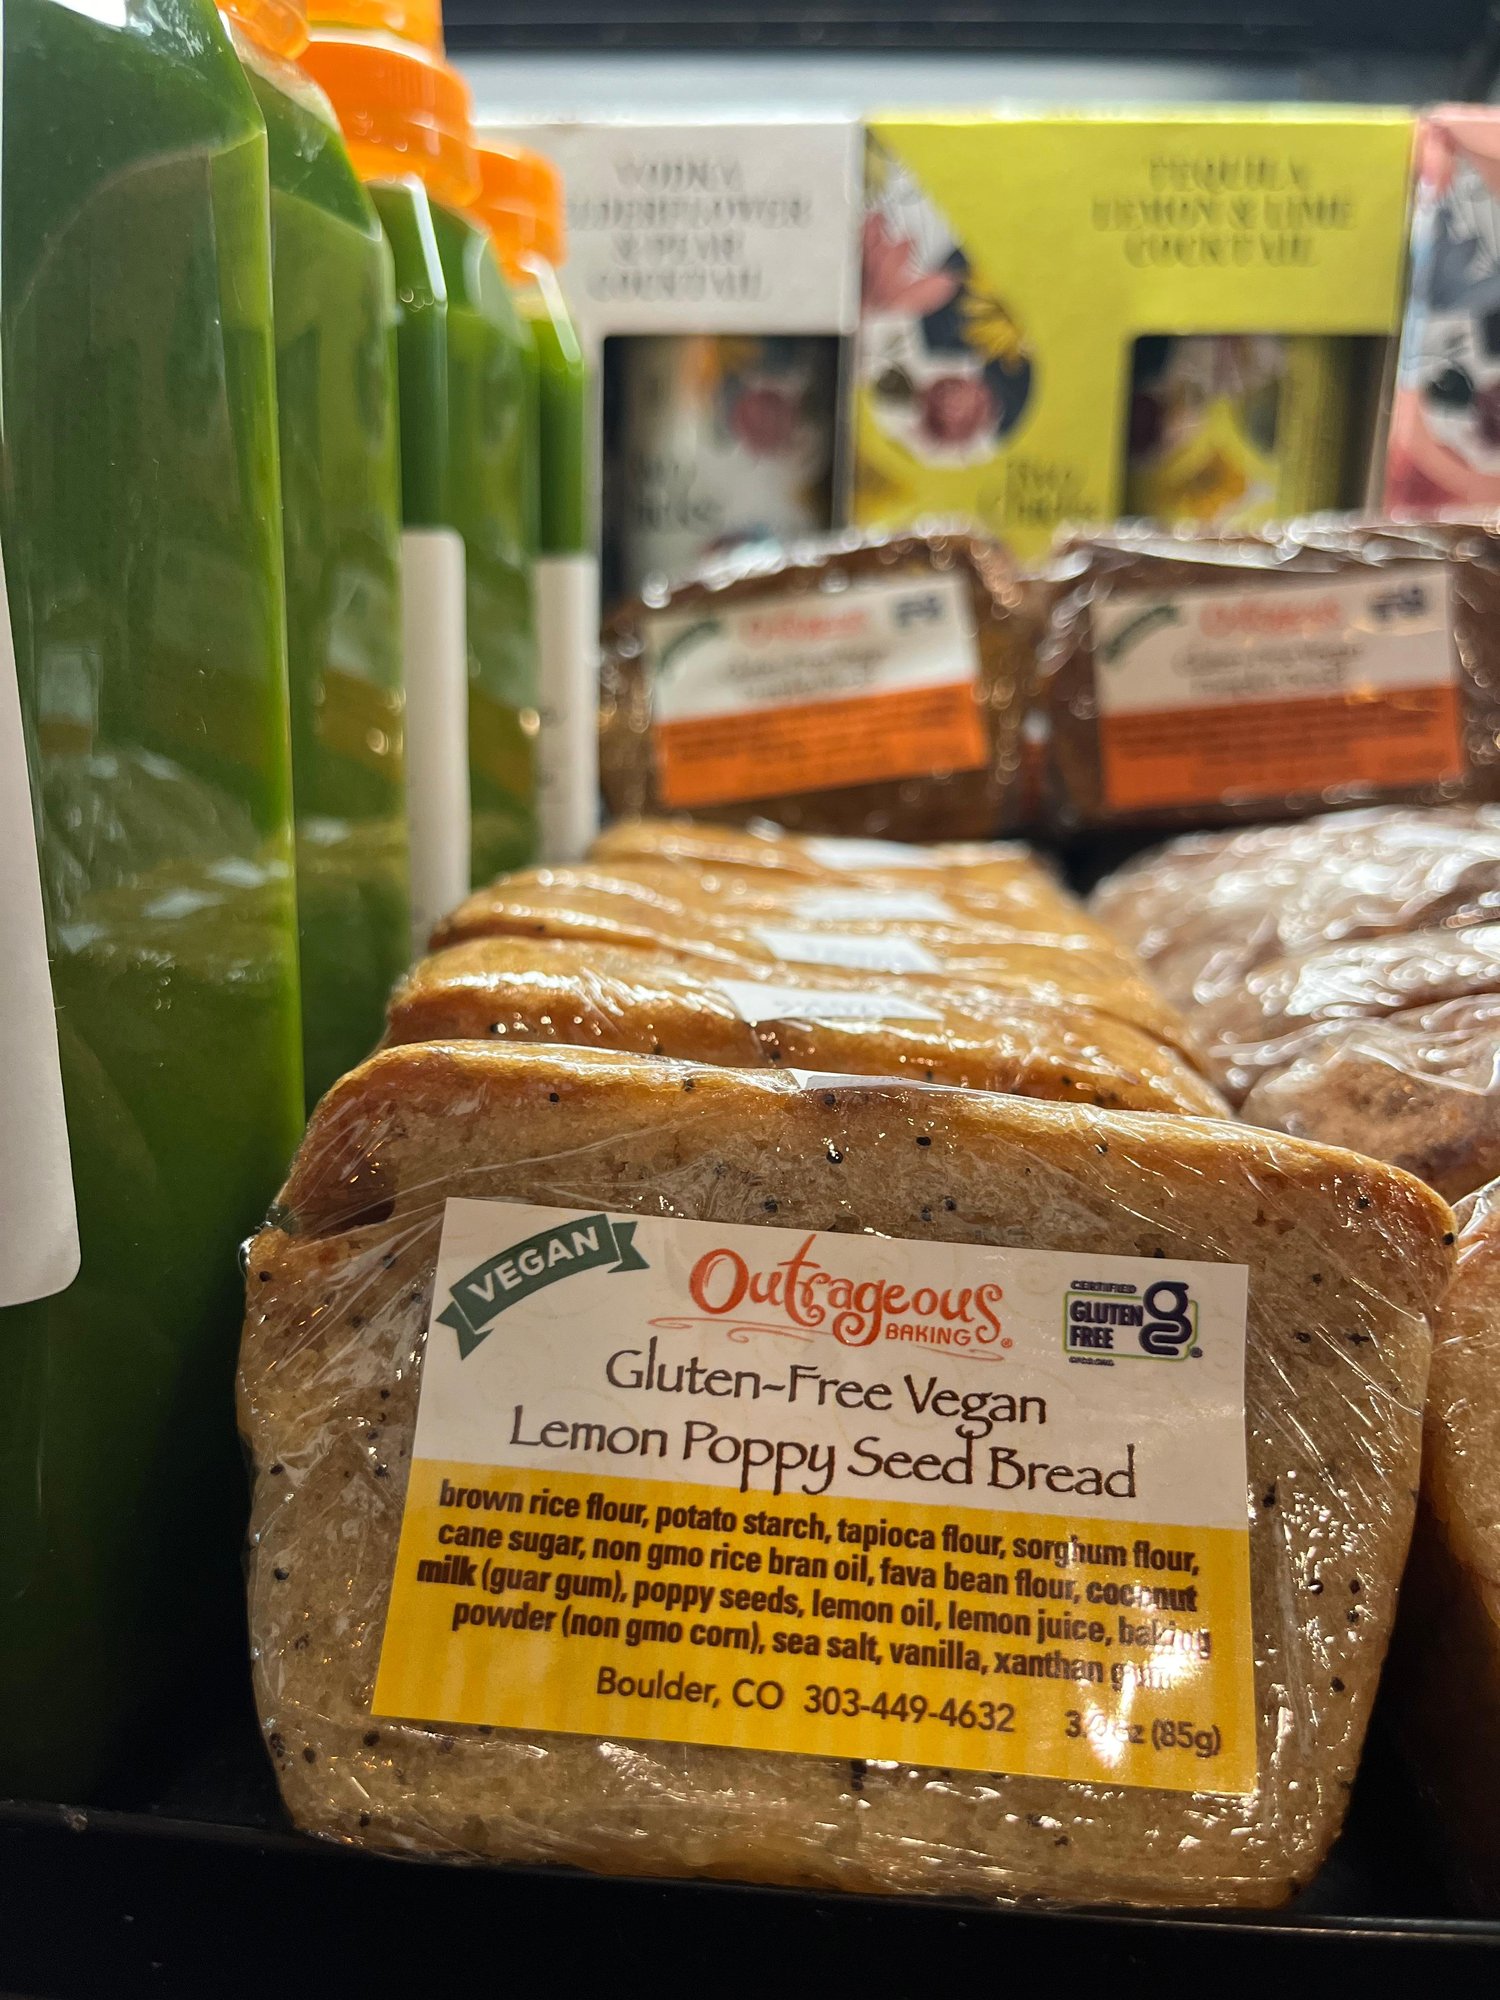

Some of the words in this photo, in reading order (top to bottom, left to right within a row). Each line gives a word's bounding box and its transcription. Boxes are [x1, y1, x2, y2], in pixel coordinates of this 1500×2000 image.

[466, 1225, 601, 1303] VEGAN
[688, 1234, 1004, 1347] Outrageous
[885, 1323, 972, 1347] BAKING
[1069, 1300, 1144, 1327] GLUTEN
[1069, 1325, 1114, 1349] FREE
[606, 1336, 893, 1411] Gluten-Free
[904, 1374, 1047, 1439] Vegan
[509, 1405, 668, 1457] Lemon
[683, 1420, 836, 1496] Poppy
[847, 1431, 973, 1485] Seed
[987, 1443, 1137, 1499] Bread
[438, 1522, 502, 1549] cane
[508, 1528, 586, 1561] sugar,
[593, 1537, 640, 1563] non
[647, 1543, 704, 1571] gmo
[710, 1542, 762, 1573] rice
[769, 1547, 827, 1579] bran
[834, 1554, 874, 1587] oil,
[880, 1561, 936, 1589] fava
[944, 1562, 1008, 1596] bean
[1015, 1571, 1080, 1604] flour,
[439, 1479, 522, 1512] brown
[528, 1488, 580, 1519] rice
[586, 1492, 650, 1529] flour,
[655, 1505, 737, 1534] potato
[743, 1511, 831, 1546] starch,
[837, 1518, 935, 1551] tapioca
[941, 1523, 1006, 1559] flour,
[1012, 1534, 1127, 1569] sorghum
[1133, 1539, 1200, 1577] flour,
[417, 1555, 479, 1588] milk
[482, 1558, 552, 1594] (guar
[556, 1570, 628, 1604] gum),
[633, 1579, 715, 1613] poppy
[720, 1583, 805, 1619] seeds,
[813, 1589, 895, 1623] lemon
[901, 1598, 942, 1631] oil,
[949, 1600, 1031, 1637] lemon
[1037, 1608, 1112, 1647] juice,
[452, 1602, 557, 1631] powder
[562, 1605, 620, 1639] (non
[626, 1620, 683, 1647] gmo
[690, 1621, 765, 1655] corn),
[772, 1628, 819, 1656] sea
[827, 1631, 882, 1666] salt,
[890, 1638, 988, 1675] vanilla,
[994, 1650, 1104, 1683] xanthan
[596, 1666, 720, 1709] Boulder,
[732, 1678, 785, 1711] CO
[803, 1684, 1016, 1733] 303-449-4632
[1151, 1718, 1222, 1759] (85g)
